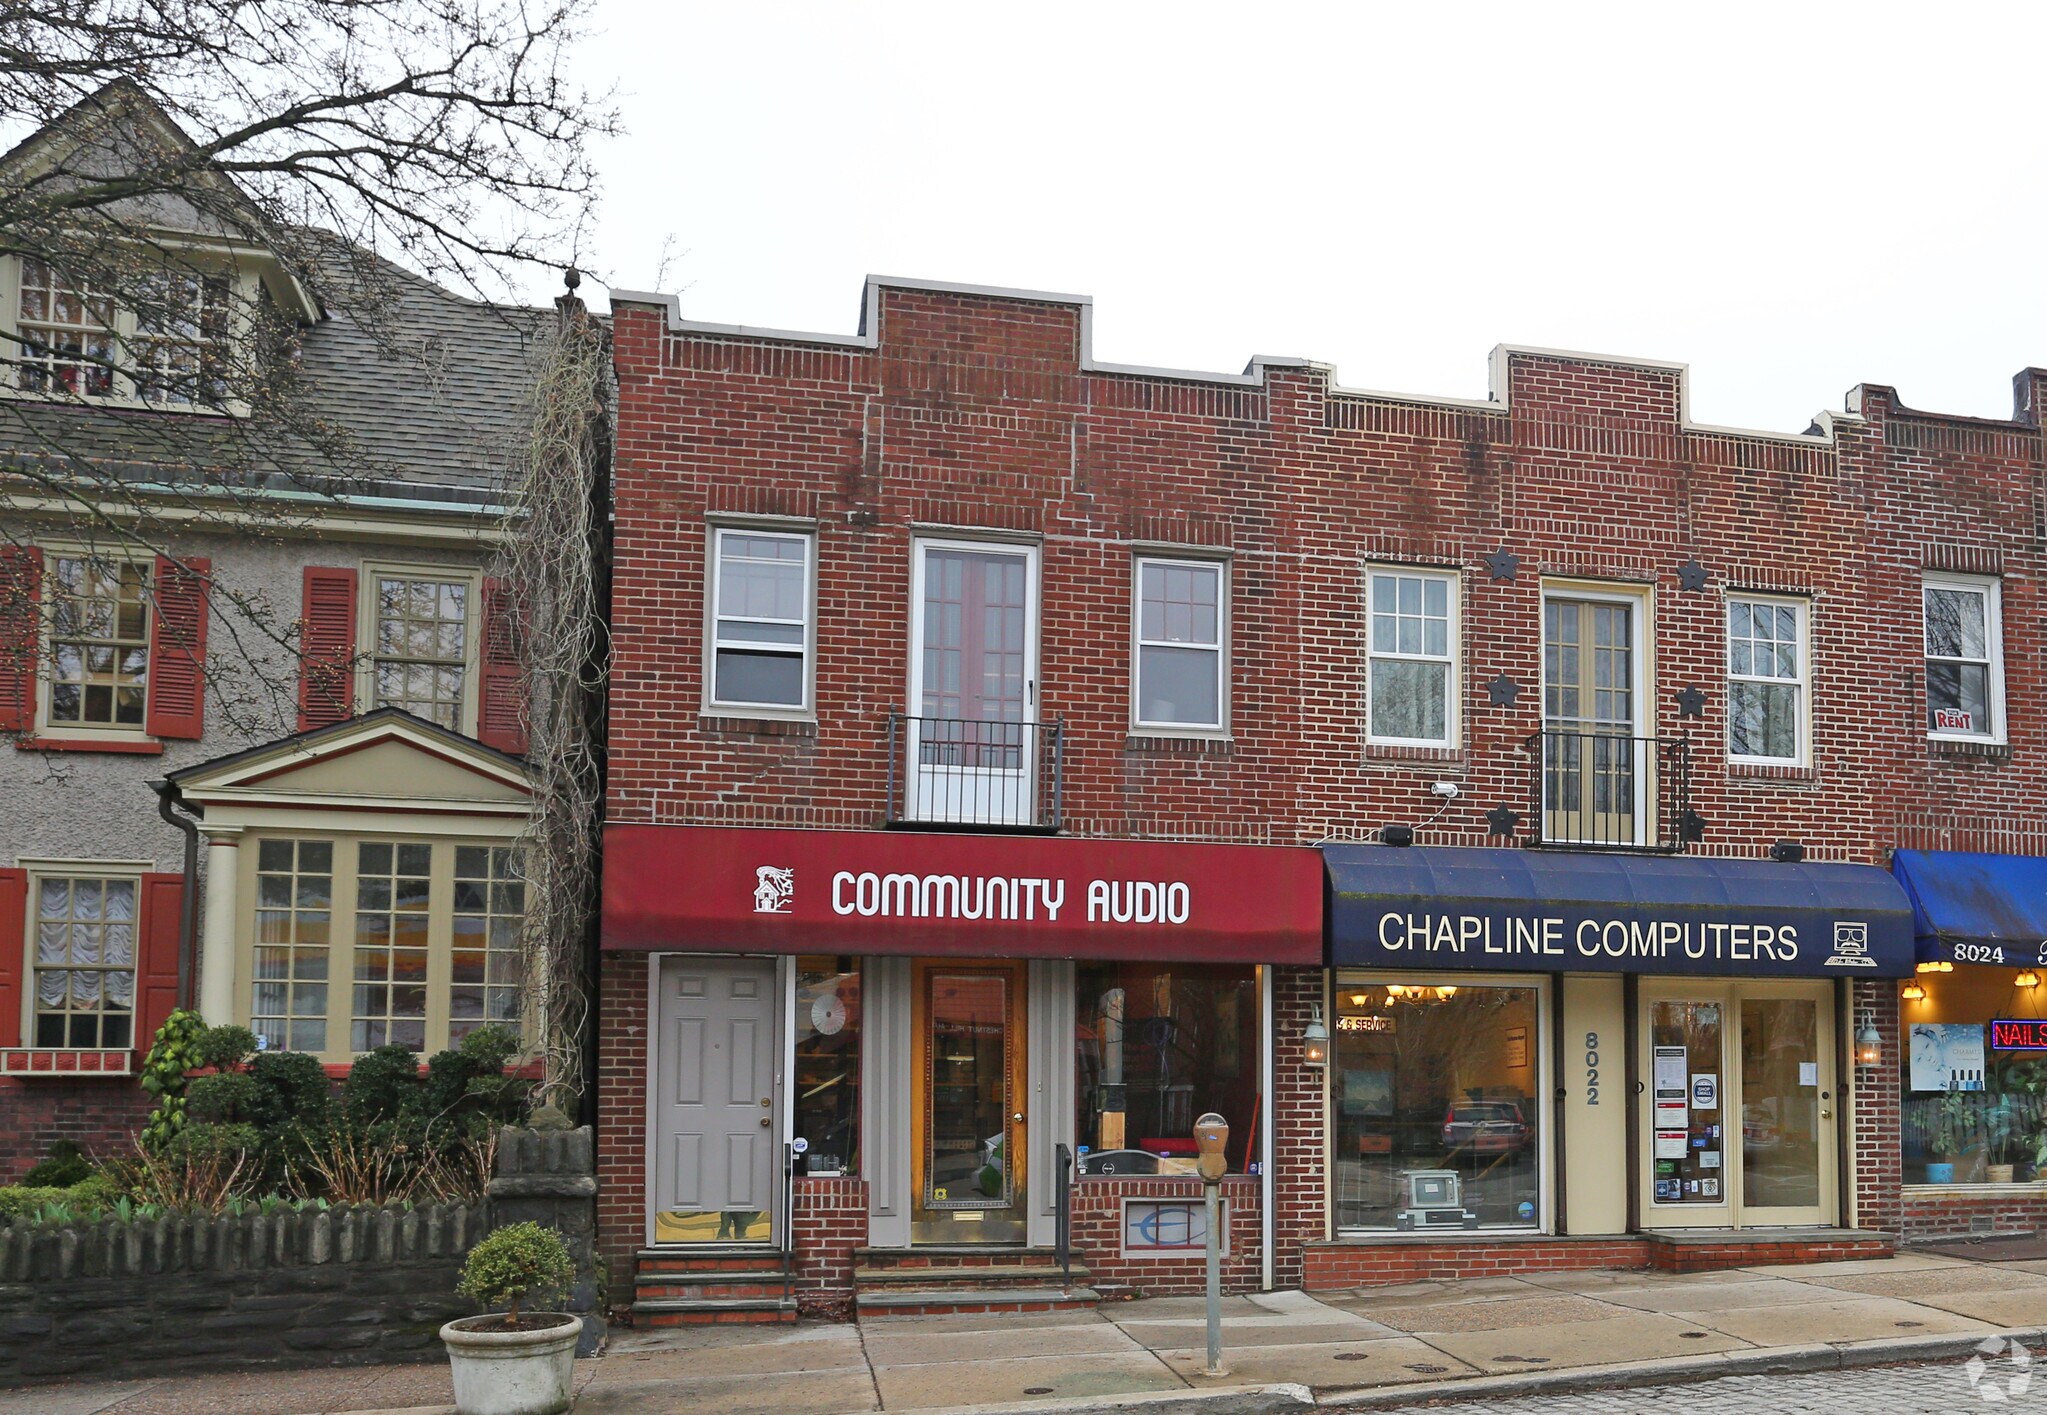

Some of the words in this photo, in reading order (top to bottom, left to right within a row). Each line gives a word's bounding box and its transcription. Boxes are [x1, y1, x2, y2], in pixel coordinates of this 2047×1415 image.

[1937, 711, 1970, 729] RENT
[832, 871, 1064, 921] COMMUNITY
[1087, 880, 1190, 924] AUDIO
[1378, 912, 1564, 954] CHAPLINE
[1575, 919, 1799, 961] COMPUTERS
[1954, 943, 2005, 964] 8024
[1346, 1019, 1353, 1030] &
[1356, 1019, 1391, 1031] SERVICE
[1995, 1024, 2047, 1047] NAILS
[1585, 1032, 1599, 1105] 8022
